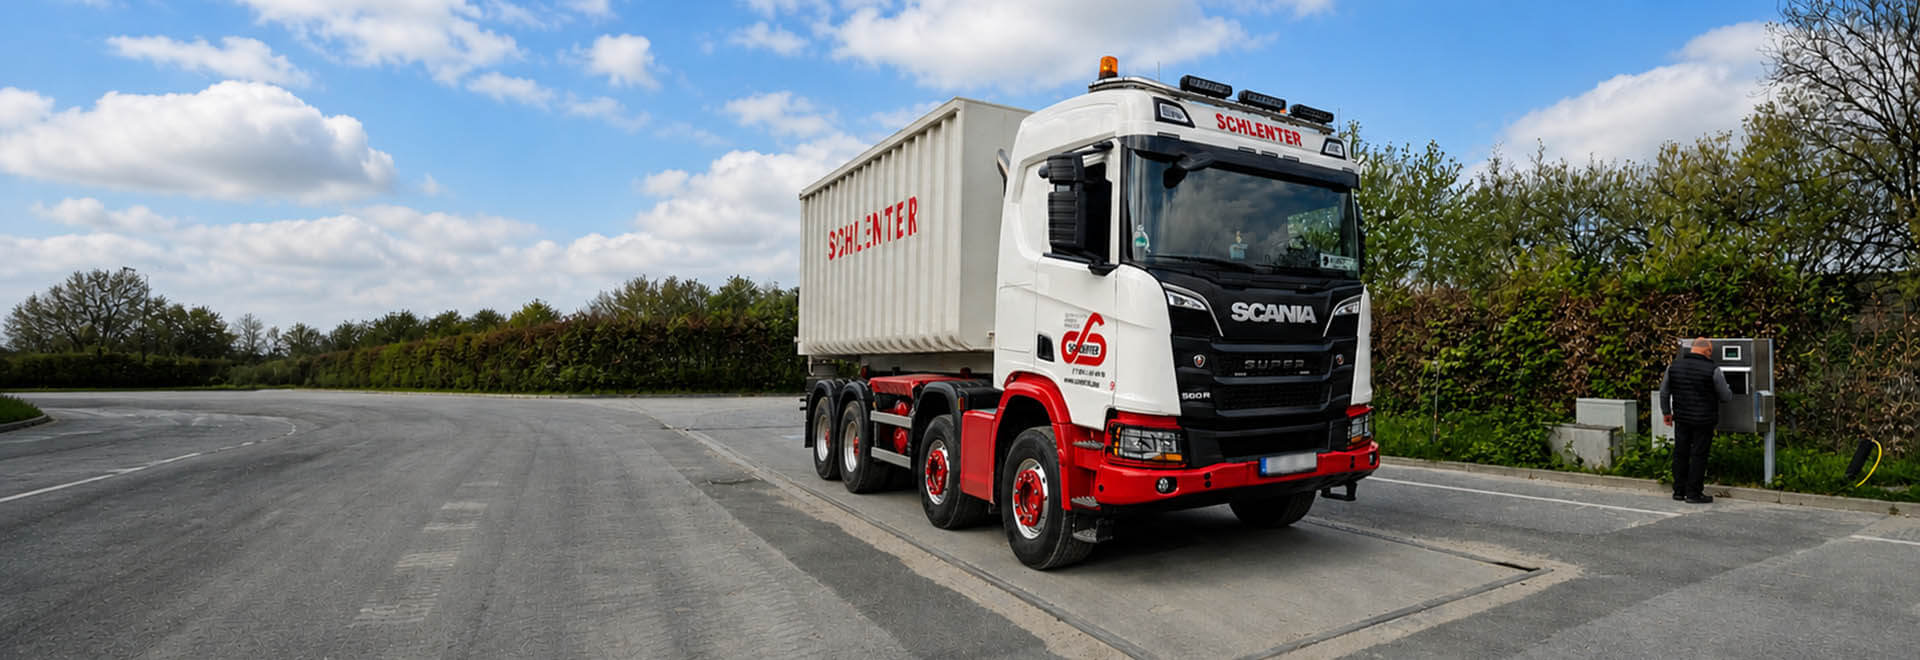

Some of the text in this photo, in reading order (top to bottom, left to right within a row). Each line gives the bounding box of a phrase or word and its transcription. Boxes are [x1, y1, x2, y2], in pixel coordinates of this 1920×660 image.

[1215, 112, 1302, 147] SCHLENTER
[828, 196, 918, 261] SCHLENTER
[1231, 302, 1317, 324] SCANIA
[1244, 359, 1305, 370] SUPER
